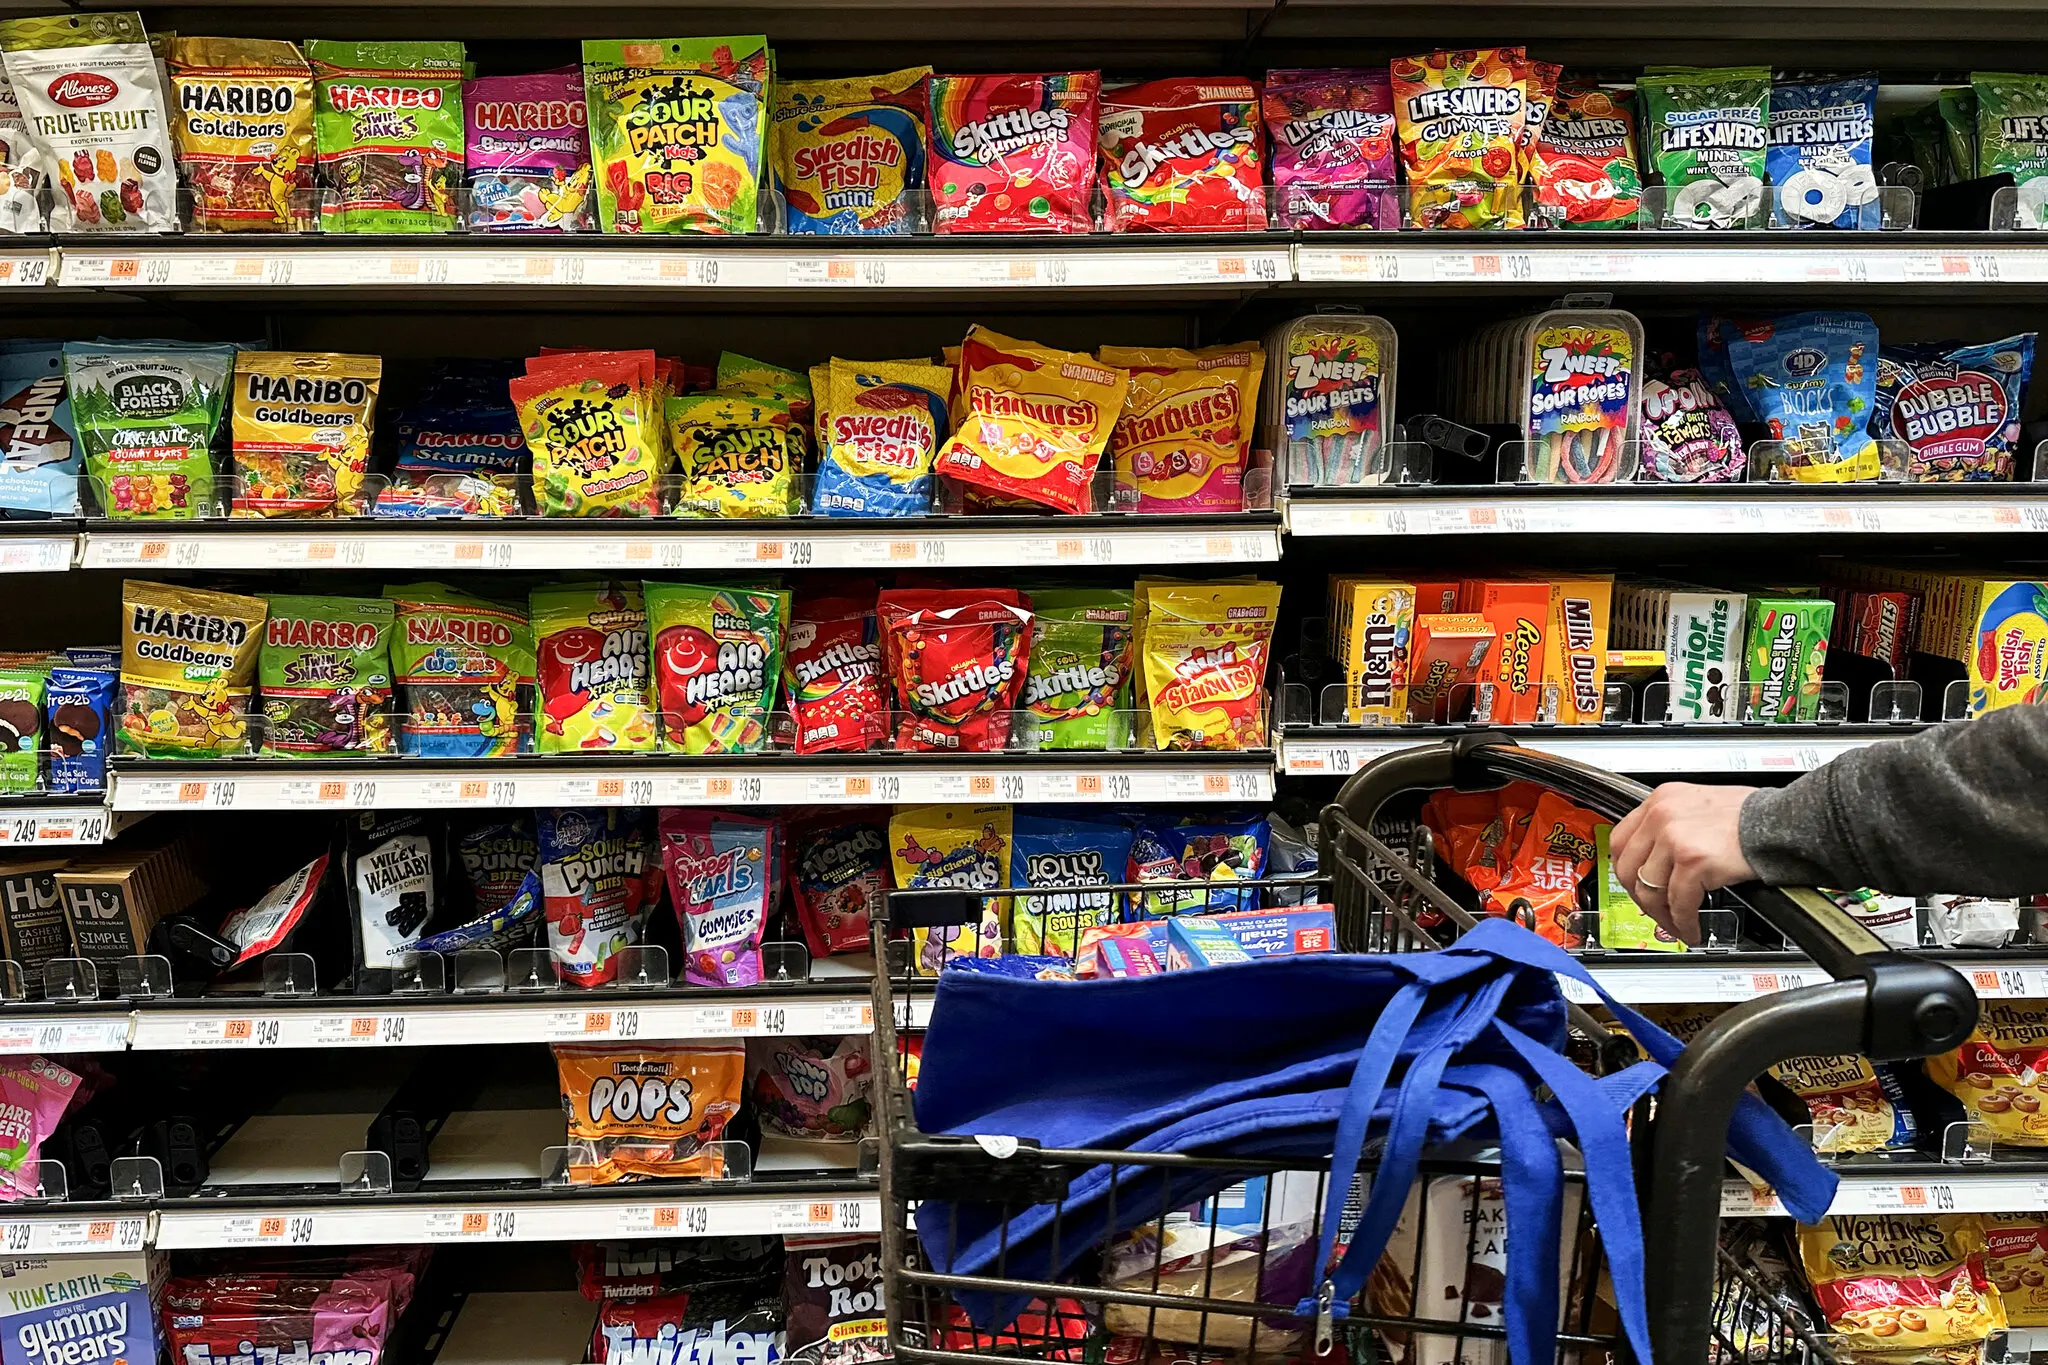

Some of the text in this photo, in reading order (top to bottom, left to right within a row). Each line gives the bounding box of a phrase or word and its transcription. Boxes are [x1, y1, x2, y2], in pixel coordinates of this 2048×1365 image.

[55, 80, 113, 100] Albanese
[594, 70, 628, 84] SHARE
[182, 85, 293, 114] HARIBO
[330, 86, 443, 112] HARIBO
[632, 98, 713, 124] SOUR
[33, 114, 79, 136] TRUE
[88, 109, 150, 132] FRUIT
[189, 119, 286, 138] Goldbears
[476, 101, 587, 130] HARIBO
[1665, 108, 1761, 124] SUGAR FREE
[1768, 105, 1866, 123] SUGAR FREE
[70, 136, 114, 145] EXOTIC FRUITS
[629, 122, 718, 152] PATCH
[954, 107, 1070, 158] Skittles
[1421, 118, 1511, 142] GUMMIES
[482, 135, 527, 155] Berry
[793, 135, 900, 178] Swedish
[1121, 126, 1255, 188] Skittles
[1696, 149, 1740, 163] MINTS
[645, 171, 692, 195] BIG
[817, 160, 880, 190] Fish
[826, 189, 874, 210] mini
[119, 393, 179, 409] FOREST
[120, 383, 173, 398] BLACK
[248, 375, 367, 406] HARIBO
[971, 385, 1097, 425] Starburst
[1287, 386, 1375, 418] SOUR BELTS
[1533, 382, 1626, 414] SOUR ROPES
[1781, 390, 1834, 416] BLOCKS
[1901, 383, 1993, 418] DUBBLE
[255, 408, 354, 427] Goldbears
[547, 410, 615, 446] SOUR
[1113, 385, 1240, 446] Starburst
[1561, 412, 1601, 425] RAINBOW
[1906, 407, 1999, 440] BUBBLE
[114, 447, 183, 460] GUMMY BEARS
[417, 449, 509, 468] Starmix
[550, 430, 626, 464] PATCH
[1923, 443, 1980, 457] BUBBLE GUM
[582, 470, 648, 497] Watermelon
[133, 606, 248, 646] HARIBO
[267, 617, 378, 649] HARIBO
[406, 617, 513, 647] HARIBO
[713, 615, 750, 630] bites
[1705, 598, 1729, 660] Mints
[1779, 612, 1797, 652] Ike
[137, 640, 234, 669] Goldbears
[602, 629, 646, 657] AIR
[717, 641, 764, 671] AIR
[1510, 617, 1543, 696] Reese's
[1564, 597, 1601, 713] Milk Duds
[299, 653, 338, 668] TWIN
[424, 656, 498, 674] Worms
[794, 642, 880, 688] Skittles
[1678, 615, 1710, 719] Junior
[1998, 627, 2032, 691] Swedish Fish
[2034, 636, 2046, 680] ASSORTED
[570, 654, 647, 693] HEADS
[587, 676, 647, 700] XTREMES
[686, 669, 763, 706] HEADS
[915, 661, 1015, 707] Skittles
[1024, 662, 1119, 706] Skittles
[1759, 656, 1788, 717] Mike
[703, 688, 764, 713] XTREMES
[1163, 665, 1255, 714] Starburst
[369, 842, 418, 870] WILEY
[581, 837, 627, 862] SOUR
[364, 853, 432, 895] WALLABY
[563, 851, 646, 893] PUNCH
[1029, 852, 1101, 881] JOLLY
[595, 876, 622, 892] BITES
[17, 925, 62, 939] CASHEW
[699, 908, 755, 938] GUMMIES
[20, 934, 62, 947] BUTTER
[79, 931, 129, 945] SIMPLE
[1799, 1063, 1865, 1088] Original
[588, 1076, 693, 1124] POPS
[1832, 1214, 1946, 1244] Werther's
[1988, 1231, 2039, 1249] Caramel
[15, 1259, 30, 1271] 15
[1857, 1239, 1954, 1272] Original
[602, 1284, 655, 1299] Twizzlers
[18, 1300, 129, 1358] gummy
[833, 1322, 863, 1338] Share
